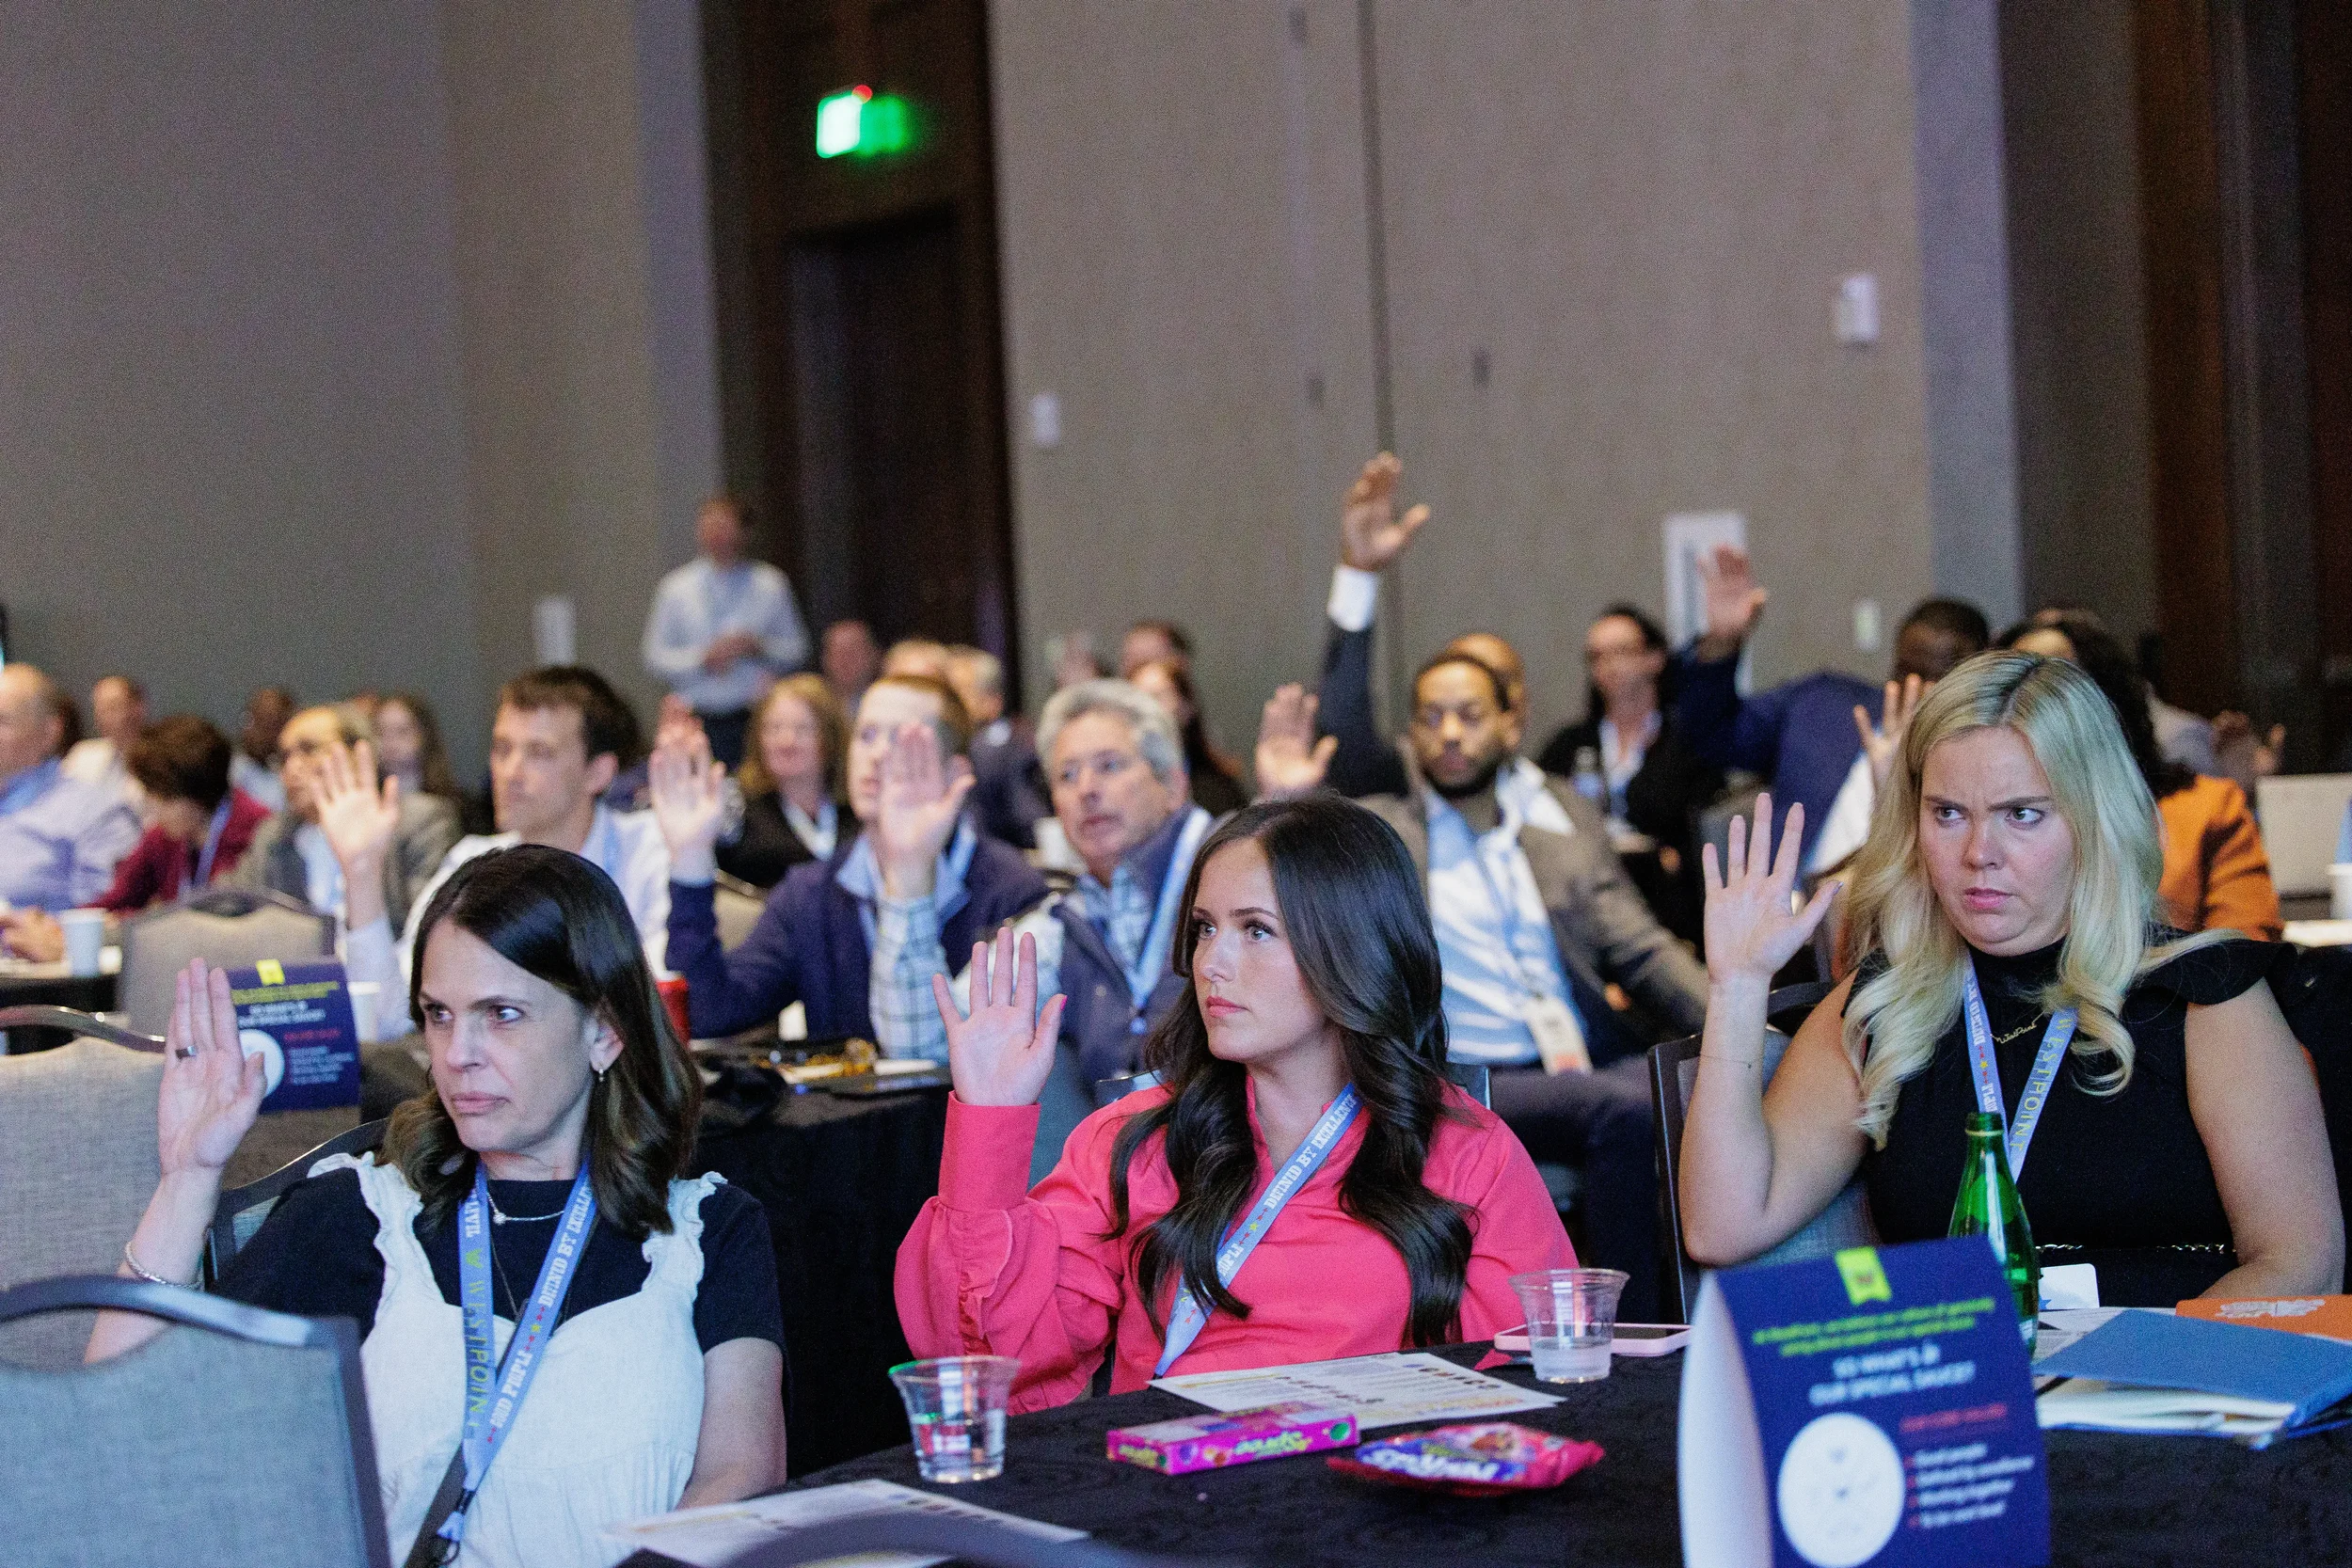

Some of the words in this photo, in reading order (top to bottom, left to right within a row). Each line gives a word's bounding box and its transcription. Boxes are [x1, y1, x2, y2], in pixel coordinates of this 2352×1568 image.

[2010, 1017, 2073, 1150] WESTPOINT
[1263, 1164, 1303, 1210] DEFINED
[1295, 1145, 1317, 1167] BY
[537, 1257, 568, 1308] DEFINED
[557, 1232, 578, 1258] BY
